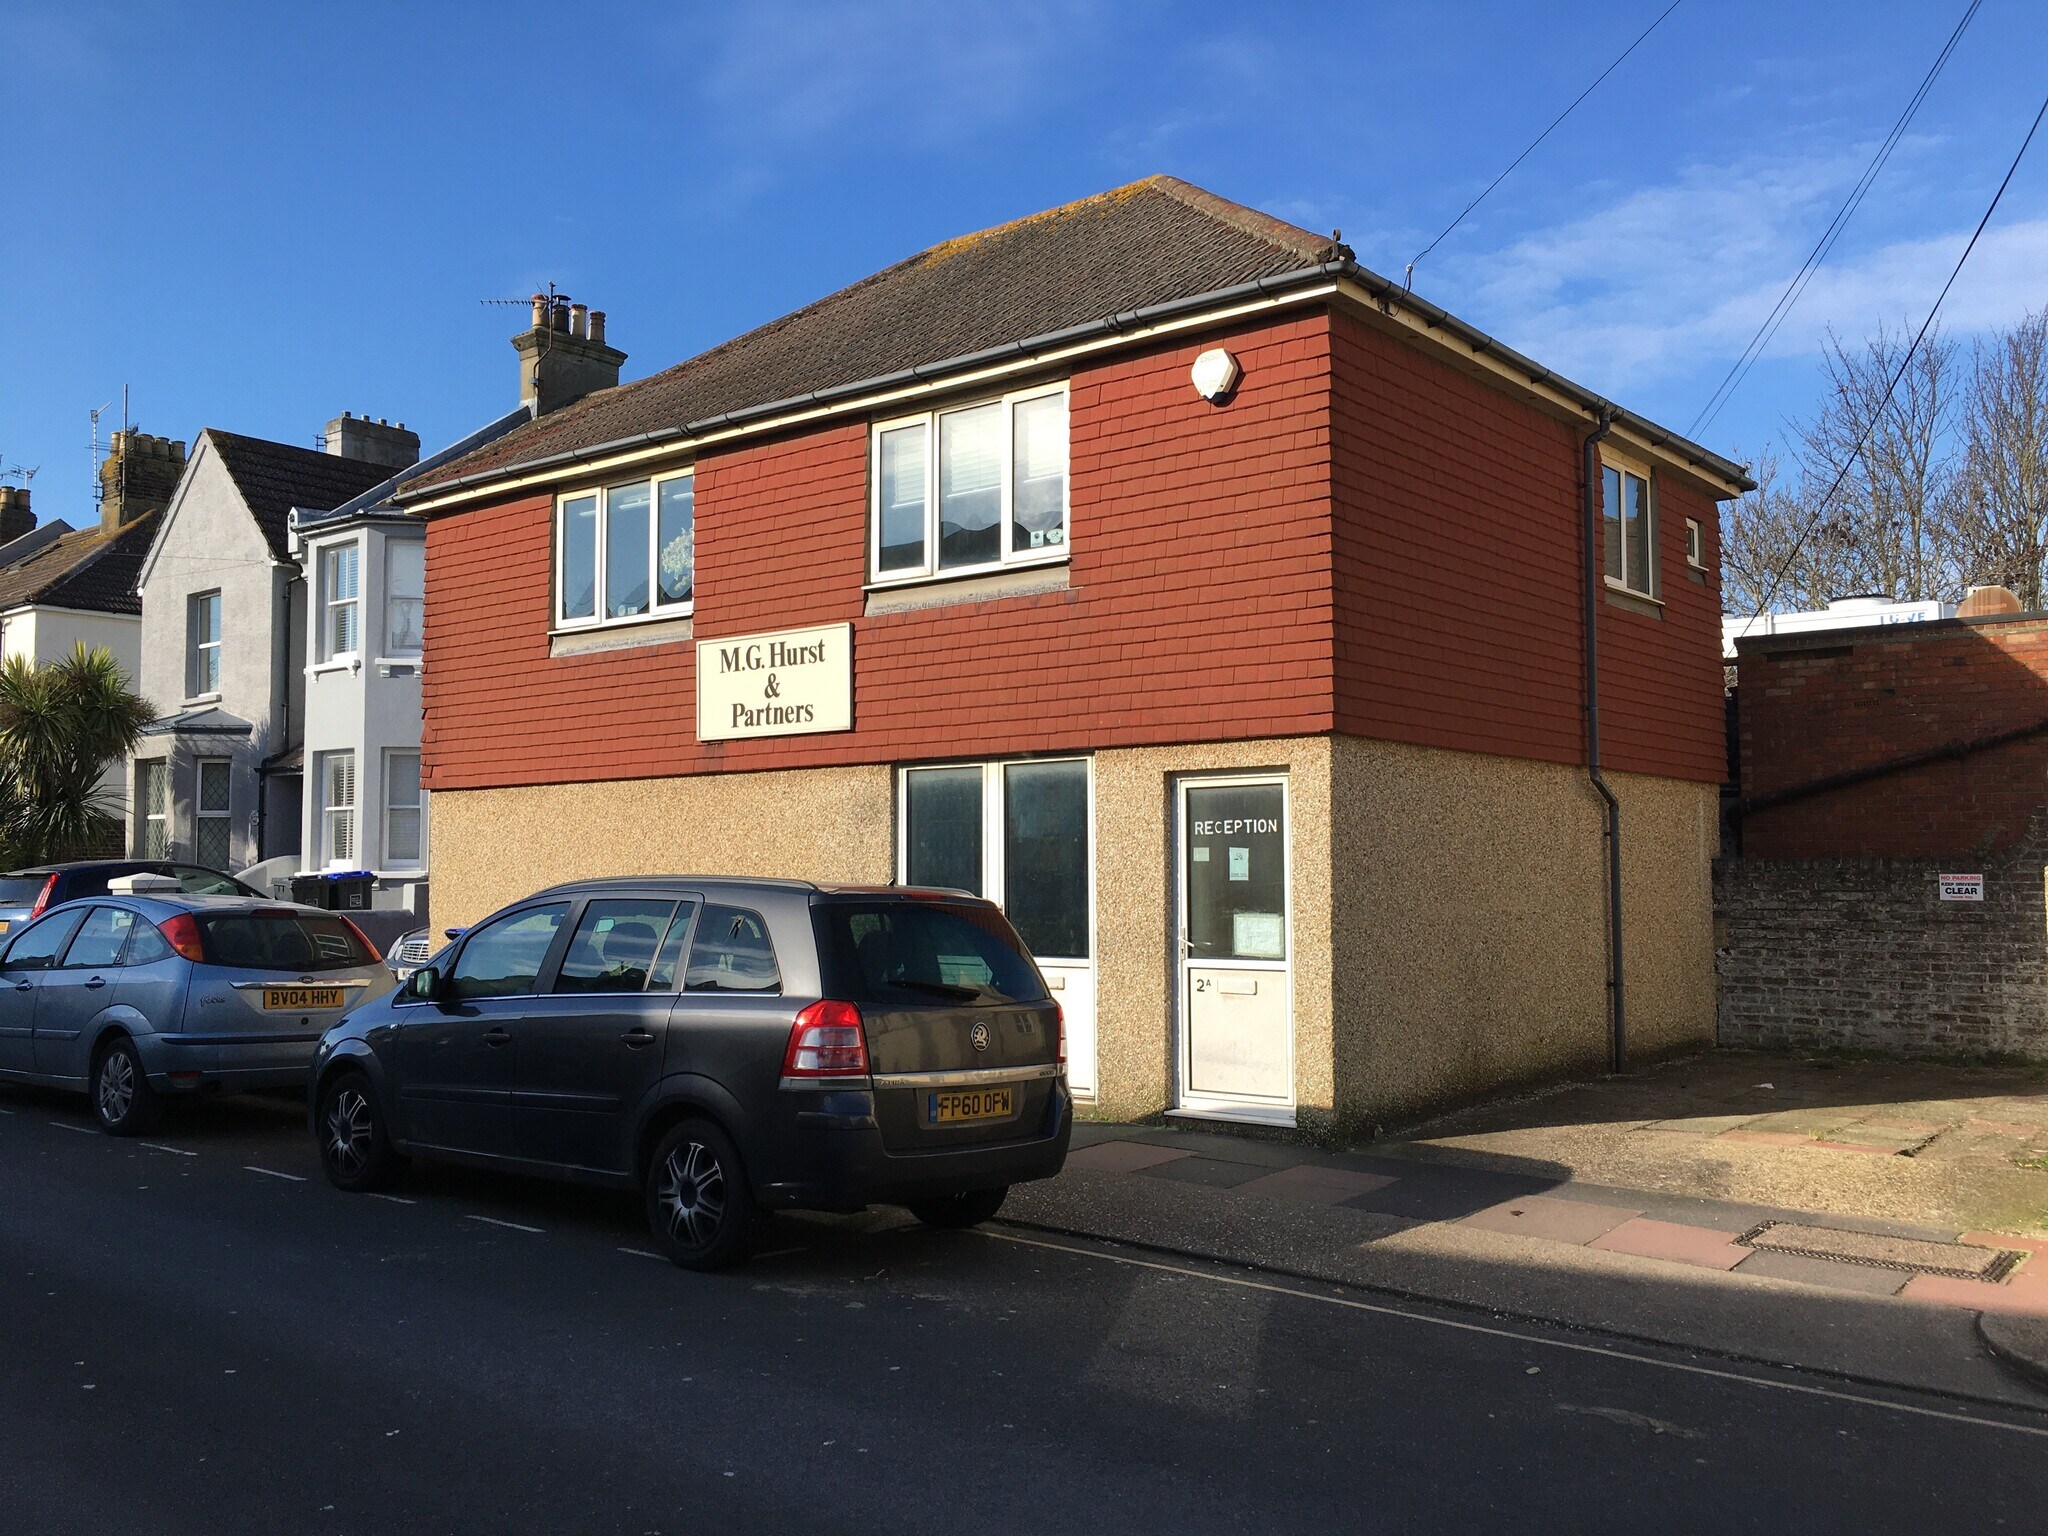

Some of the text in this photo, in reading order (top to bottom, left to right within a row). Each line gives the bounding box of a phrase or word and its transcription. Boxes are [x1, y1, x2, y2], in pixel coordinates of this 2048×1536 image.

[719, 638, 826, 674] M.G. Hurst
[764, 672, 781, 699] &
[730, 702, 814, 729] Partners
[1194, 818, 1278, 836] RECEPTION
[1945, 887, 1978, 895] CLEAR
[270, 990, 338, 1006] BV04 HHY
[938, 1091, 1011, 1117] FP60 OFW
